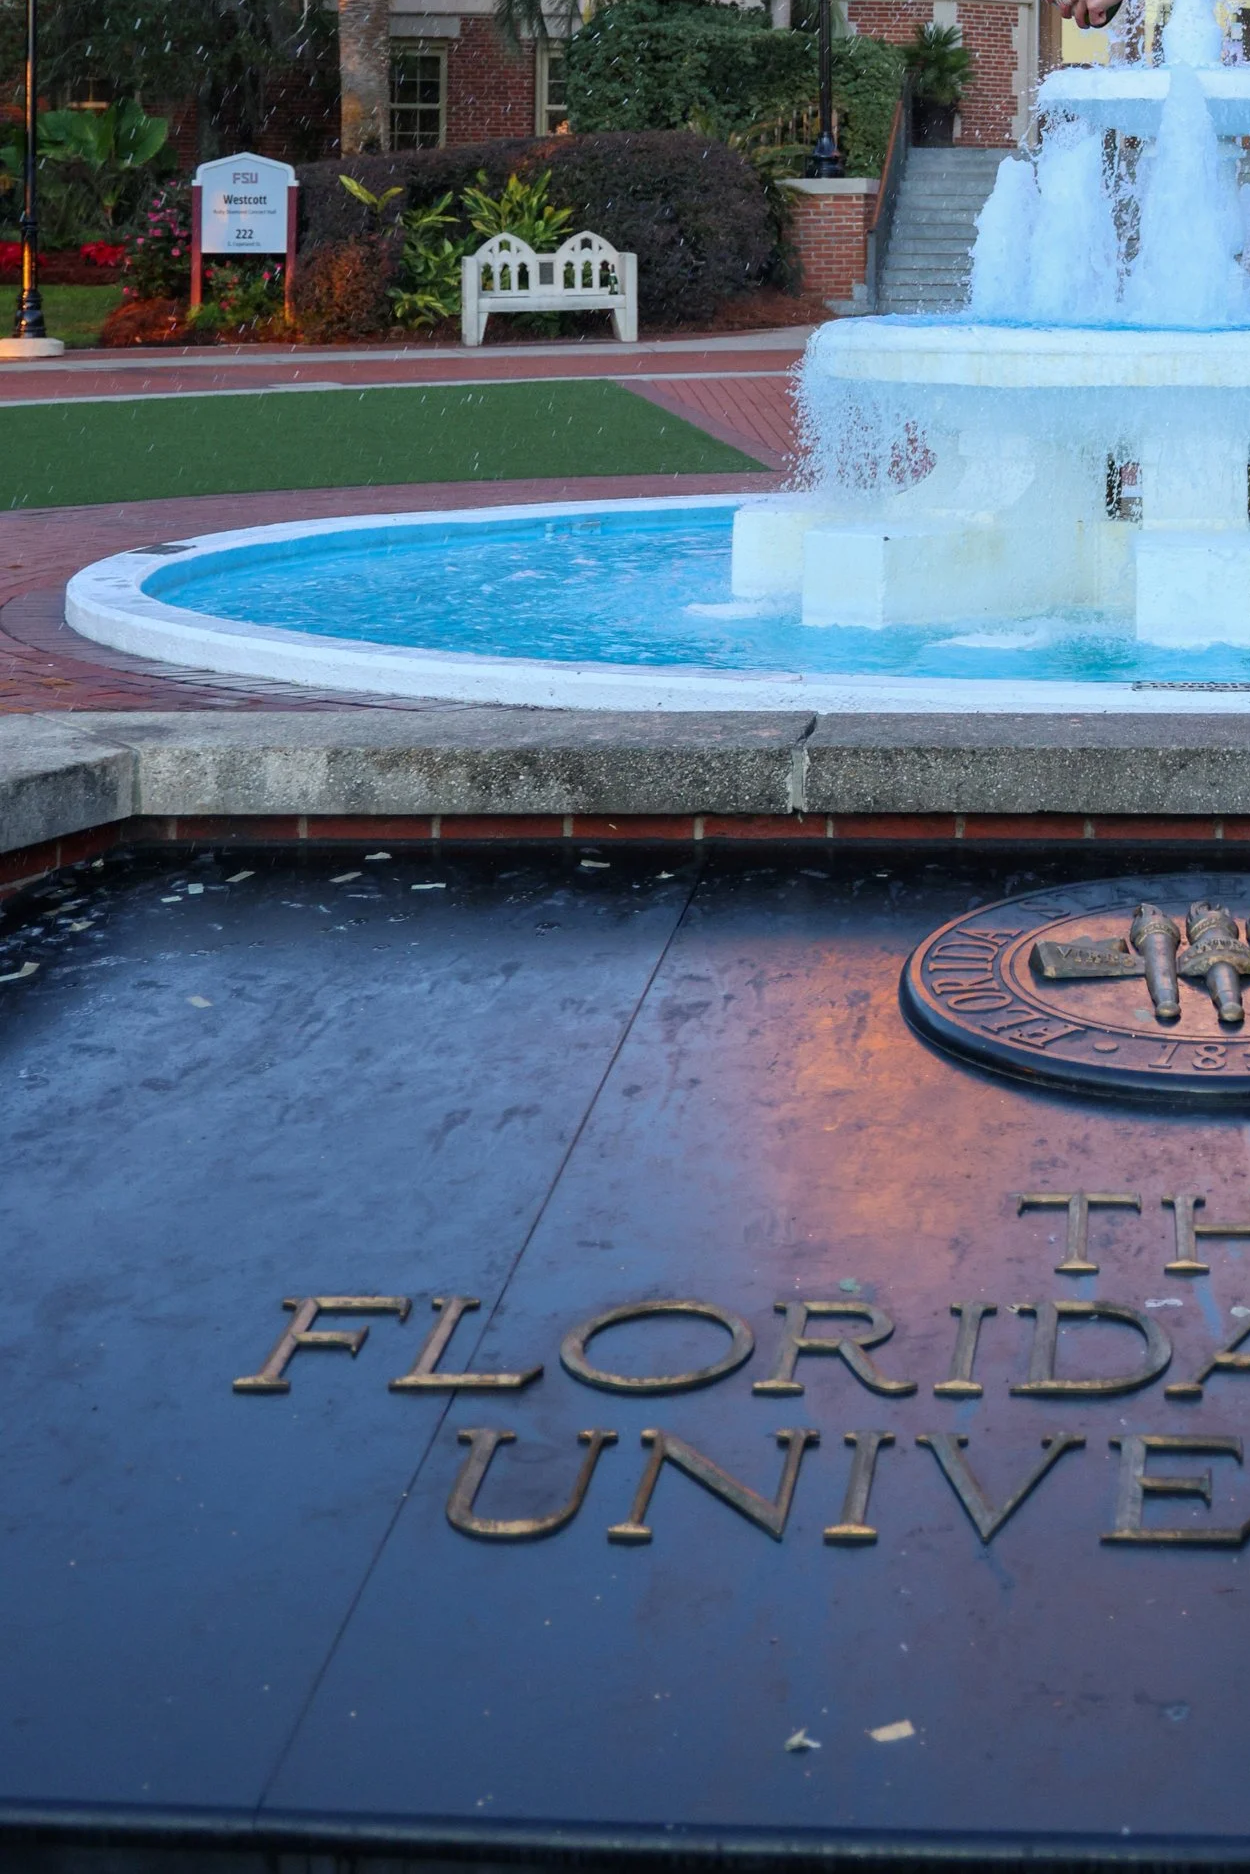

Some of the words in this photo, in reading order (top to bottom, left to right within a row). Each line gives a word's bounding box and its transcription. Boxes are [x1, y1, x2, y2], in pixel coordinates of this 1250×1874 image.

[232, 171, 259, 185] FSU
[223, 193, 268, 206] Westcott
[235, 228, 254, 240] 222
[928, 928, 1087, 1050] FLORIDA
[1017, 878, 1250, 921] STATE
